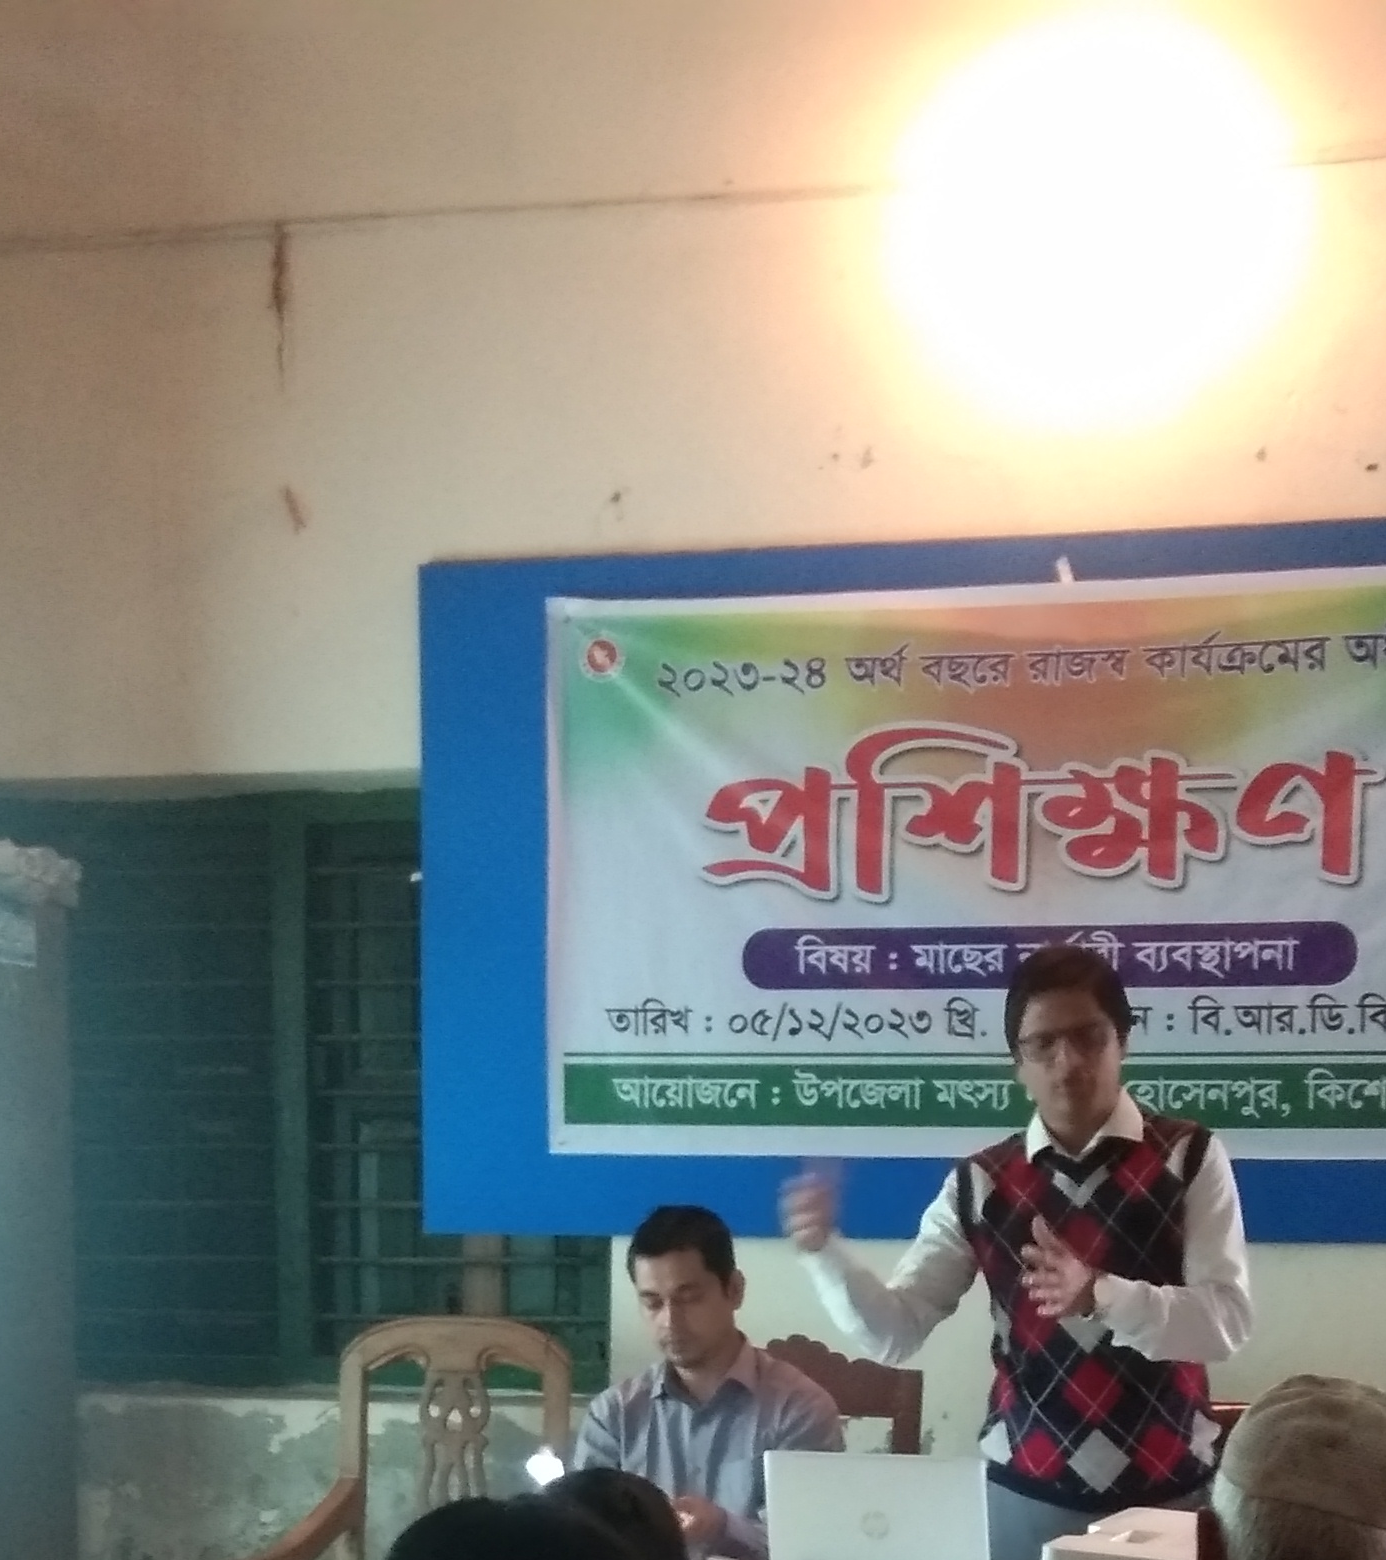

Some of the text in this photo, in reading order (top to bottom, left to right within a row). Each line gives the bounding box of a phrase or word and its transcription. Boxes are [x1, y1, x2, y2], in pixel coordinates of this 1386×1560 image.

[657, 656, 827, 698] ২০২৩-২৪
[844, 643, 910, 687] অর্থ
[919, 653, 1015, 694] বছরে
[1027, 648, 1130, 684] রাজস্ব
[1142, 630, 1331, 680] কার্যক্রমের
[700, 722, 1386, 904] প্রশিক্ষণ
[793, 934, 877, 975] বিষয়
[910, 942, 1008, 977] মাছের
[1131, 937, 1300, 979] ব্যবস্থাপনা
[604, 997, 693, 1036] তারিখ
[728, 1001, 933, 1042] ০৫/১২/২০২৩
[611, 1075, 761, 1110] আয়োজনে
[792, 1069, 925, 1110] উপজেলা
[932, 1079, 1016, 1111] মৎস্য
